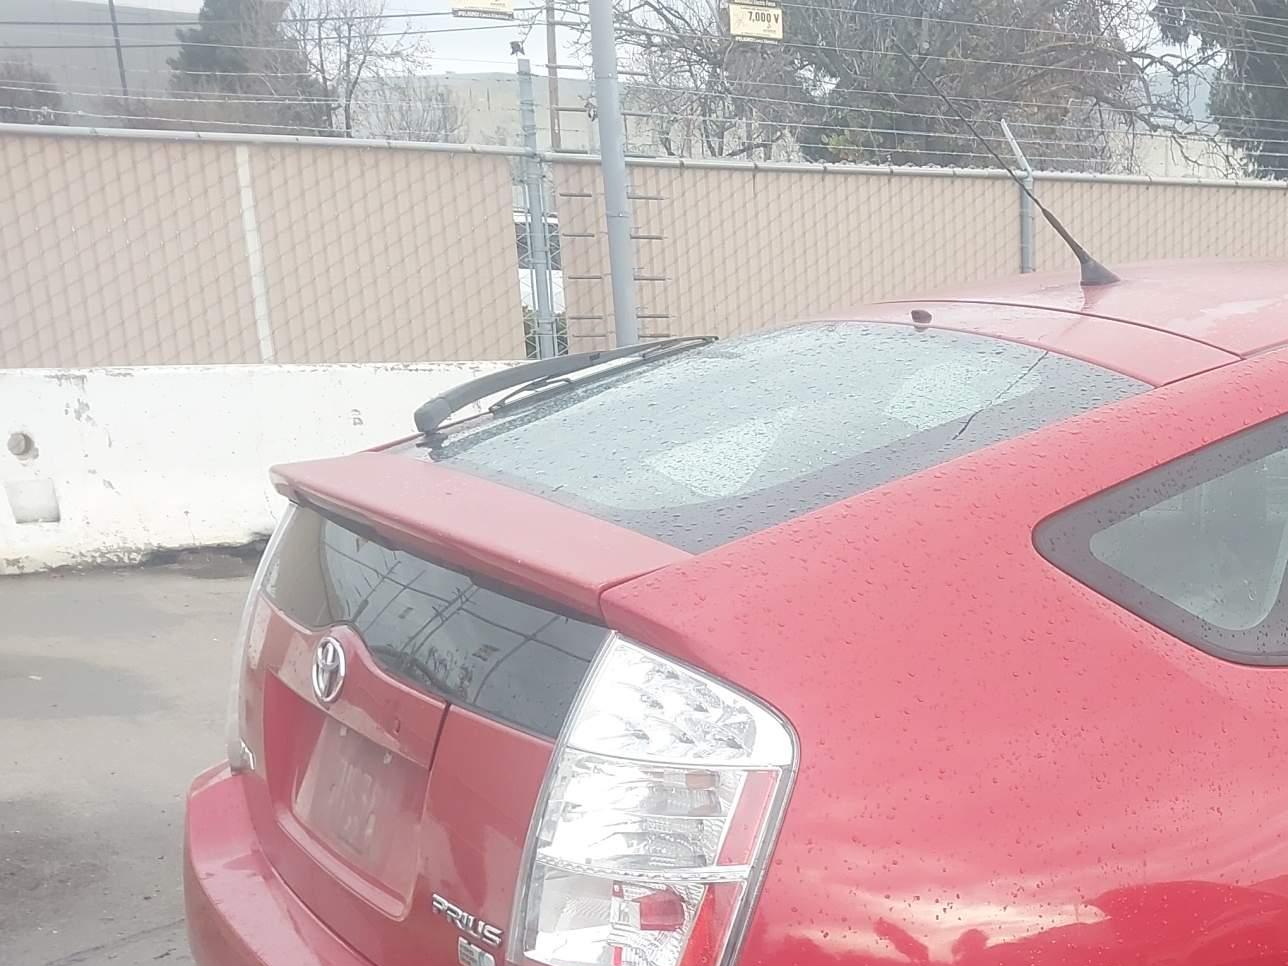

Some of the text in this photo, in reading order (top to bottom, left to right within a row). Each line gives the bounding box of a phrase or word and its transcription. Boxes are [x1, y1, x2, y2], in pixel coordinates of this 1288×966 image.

[747, 11, 780, 24] 7,000 V
[432, 893, 503, 946] PRIUS
